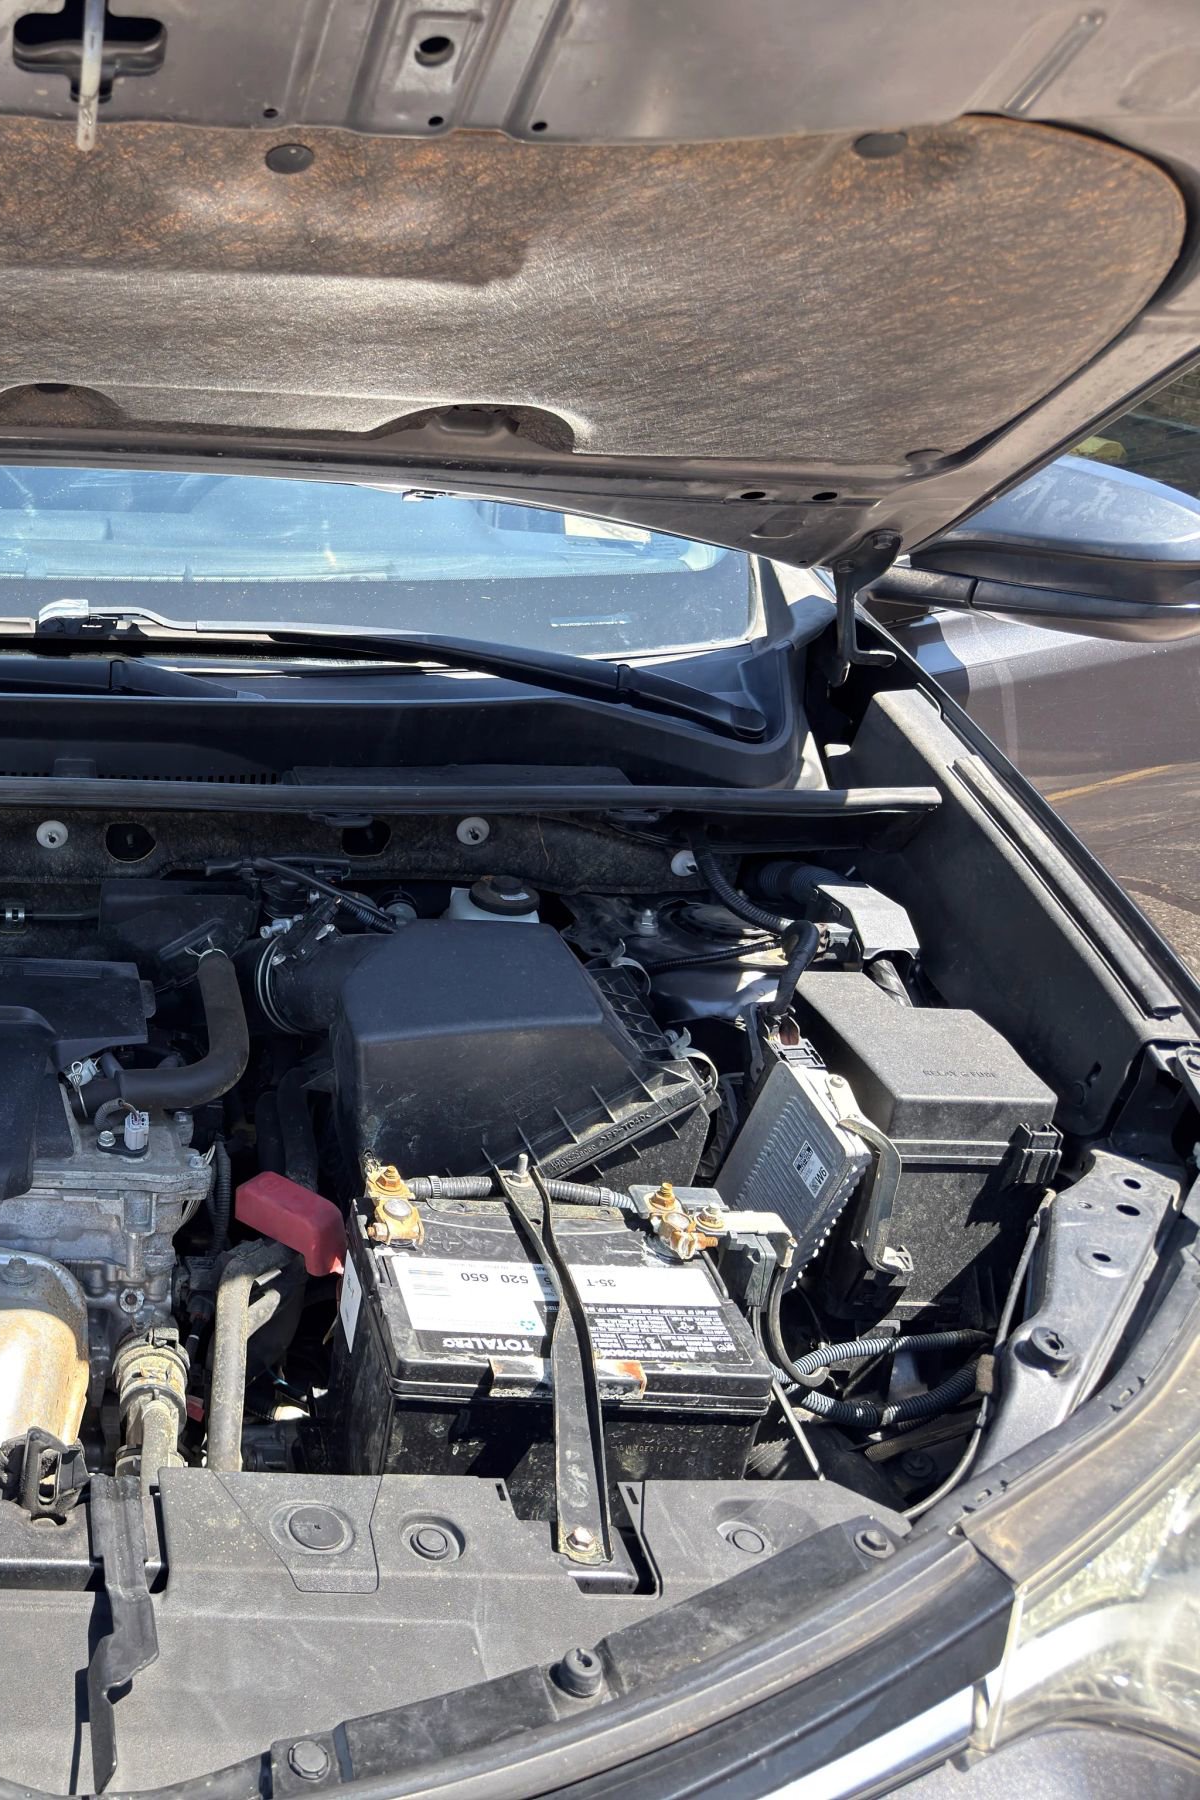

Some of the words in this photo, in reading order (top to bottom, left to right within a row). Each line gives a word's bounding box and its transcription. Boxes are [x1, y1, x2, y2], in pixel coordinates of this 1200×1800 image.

[460, 1272, 489, 1282] 650
[500, 1273, 529, 1284] 520
[586, 1278, 617, 1288] 35-T
